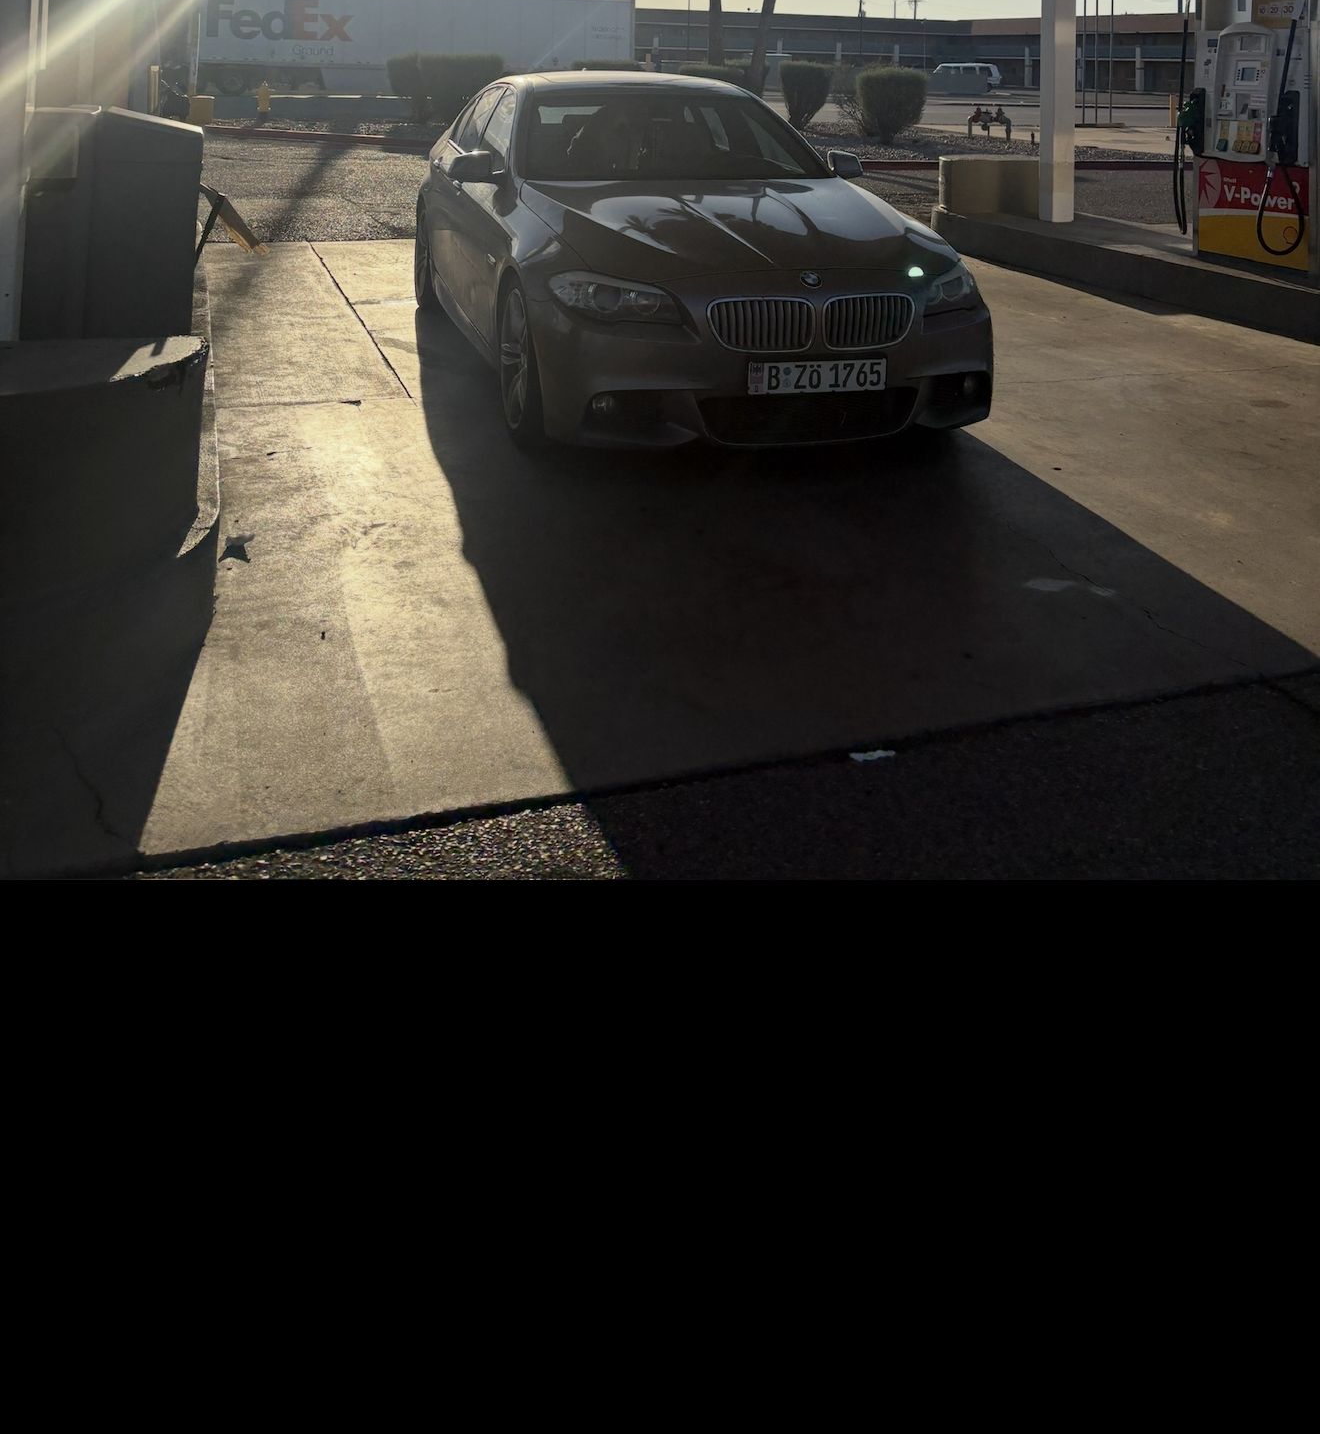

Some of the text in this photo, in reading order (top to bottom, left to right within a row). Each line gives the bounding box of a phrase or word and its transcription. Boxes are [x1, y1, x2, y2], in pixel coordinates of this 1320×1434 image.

[292, 44, 335, 55] Ground
[1223, 184, 1295, 211] V-Power
[767, 365, 781, 390] B
[828, 362, 882, 389] 1765
